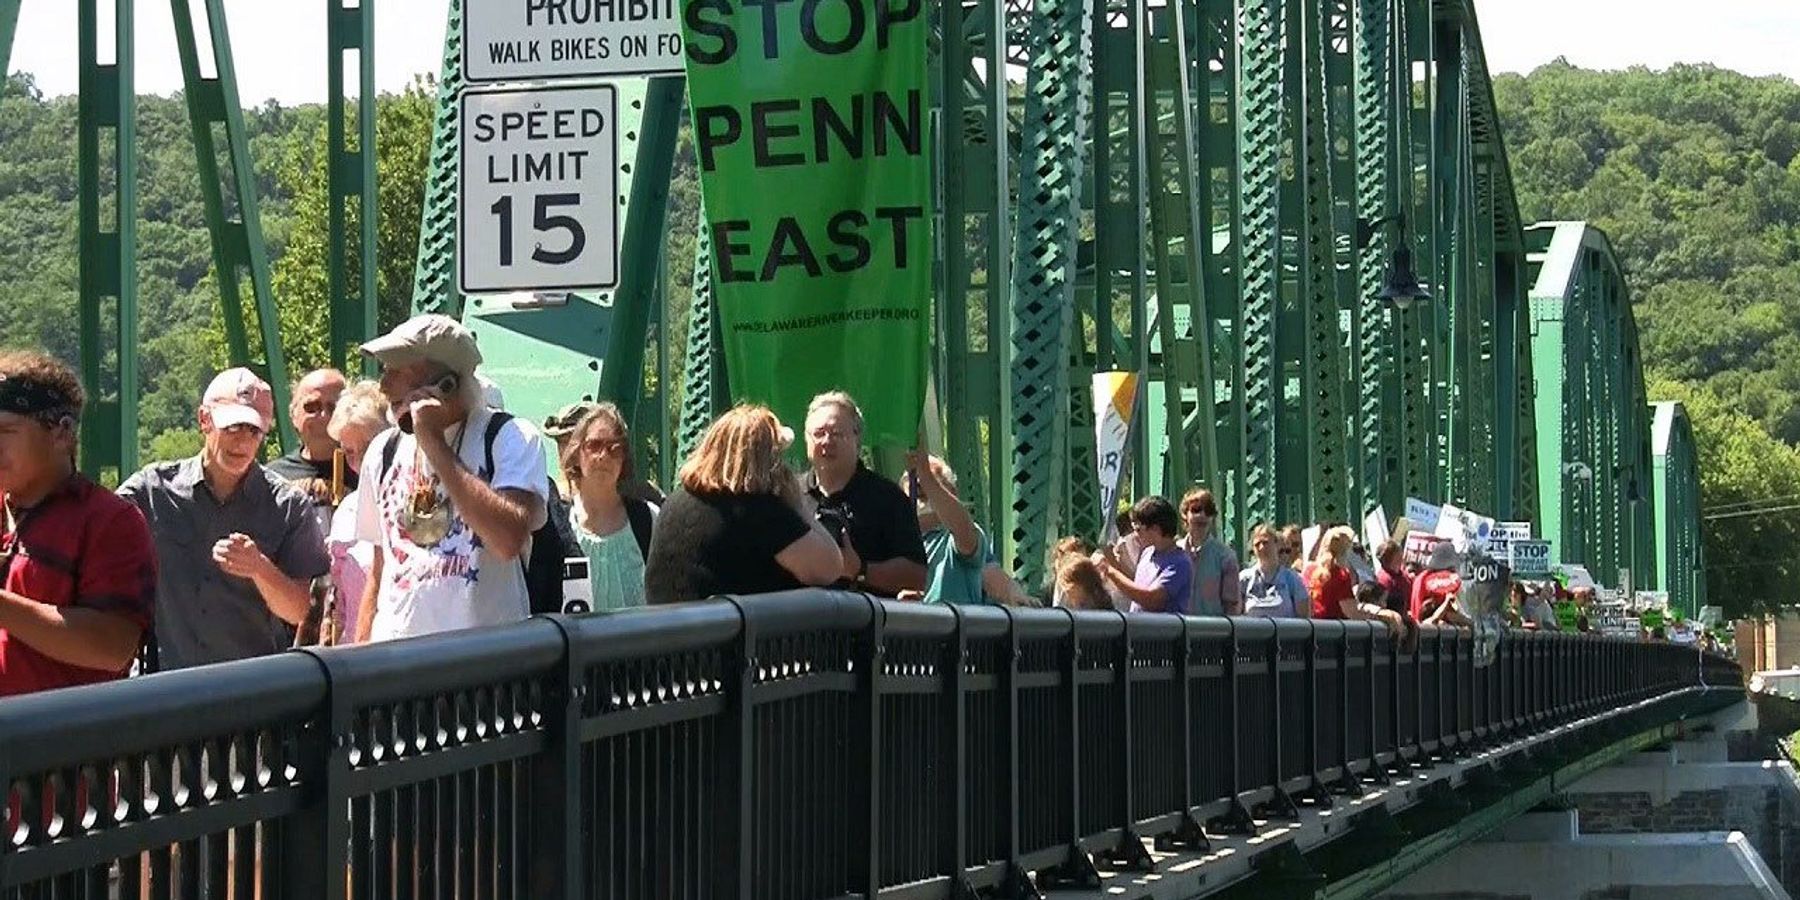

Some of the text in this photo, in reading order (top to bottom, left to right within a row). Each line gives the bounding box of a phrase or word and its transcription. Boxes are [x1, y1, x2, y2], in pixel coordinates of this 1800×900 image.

[489, 33, 682, 64] WALK BIKES ON FO
[684, 0, 922, 64] STOP
[474, 109, 604, 142] SPEED
[696, 89, 922, 172] PENN
[488, 151, 589, 183] LIMIT
[491, 193, 586, 266] 15
[711, 206, 923, 283] EAST
[1513, 545, 1549, 558] STOP
